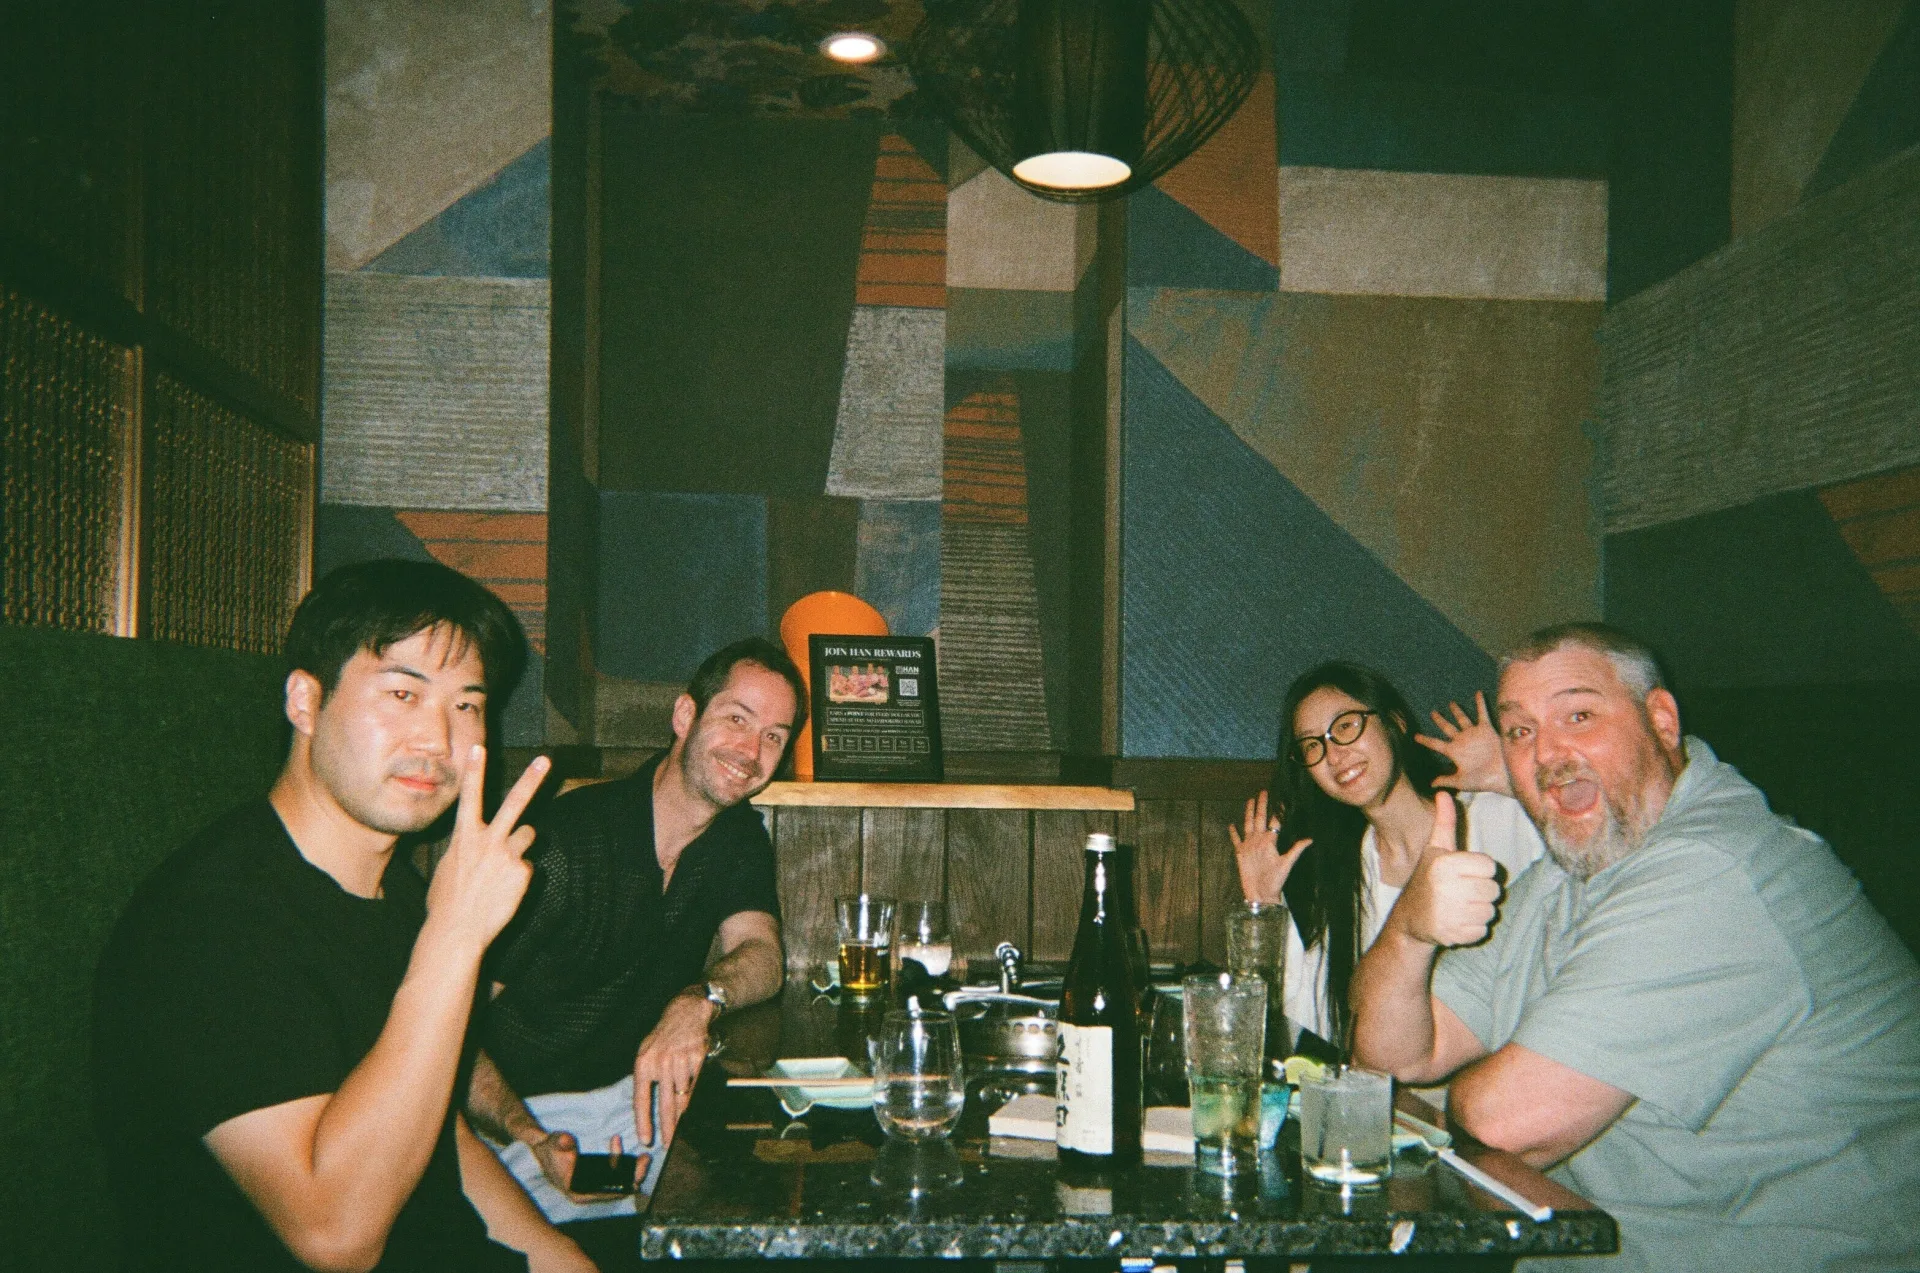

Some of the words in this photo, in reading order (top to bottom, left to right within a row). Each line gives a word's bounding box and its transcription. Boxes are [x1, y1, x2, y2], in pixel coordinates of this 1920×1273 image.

[825, 647, 847, 657] JOIN
[850, 648, 872, 656] HAN
[874, 649, 921, 658] REWARDS
[903, 666, 919, 674] HAN
